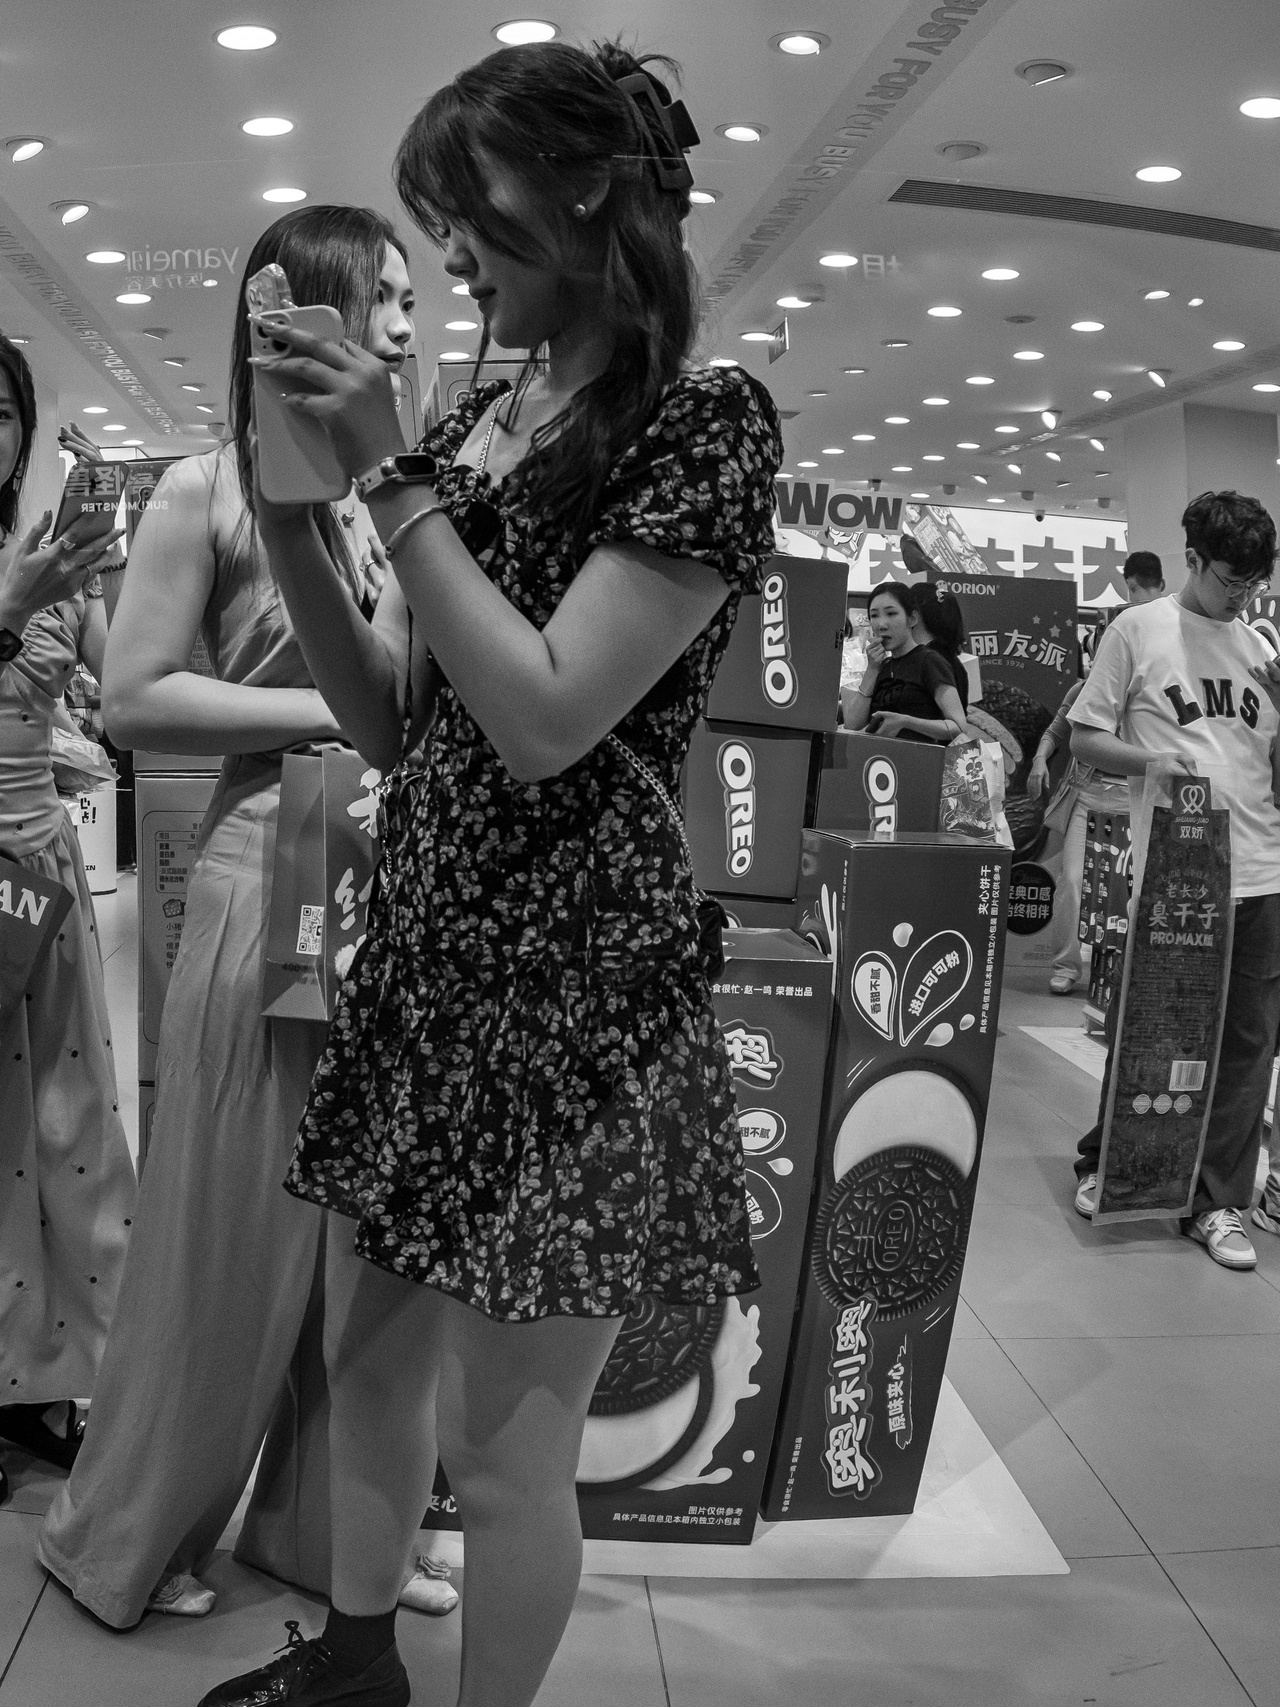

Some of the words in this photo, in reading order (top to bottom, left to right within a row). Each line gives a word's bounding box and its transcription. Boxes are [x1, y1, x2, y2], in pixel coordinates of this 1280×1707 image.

[865, 58, 932, 101] FOR
[836, 102, 897, 139] YOU
[776, 482, 903, 531] WOW
[951, 582, 996, 596] ORION
[764, 574, 796, 707] OREO
[963, 628, 1068, 673] 丽友·派
[1163, 678, 1260, 730] LMS
[721, 743, 755, 875] OREO
[1179, 825, 1205, 840] 双娇
[977, 863, 992, 915] 夹心饼干
[991, 863, 1002, 916] 图片仅供参考
[1148, 900, 1221, 930] 臭干子
[710, 983, 772, 996] 食很忙·赵一鸣
[775, 985, 813, 997] 荣誉出品
[870, 967, 882, 1015] 香甜不腻
[907, 950, 961, 1017] 进口可可粉
[745, 1190, 766, 1225] 可粉
[882, 1208, 906, 1263] OREO
[825, 1300, 875, 1492] 奥利奥
[887, 1362, 907, 1433] 原味夹心
[612, 1512, 741, 1527] 具体产品信息见本箱内独立小包装
[688, 1505, 744, 1517] 图片仅供参考
